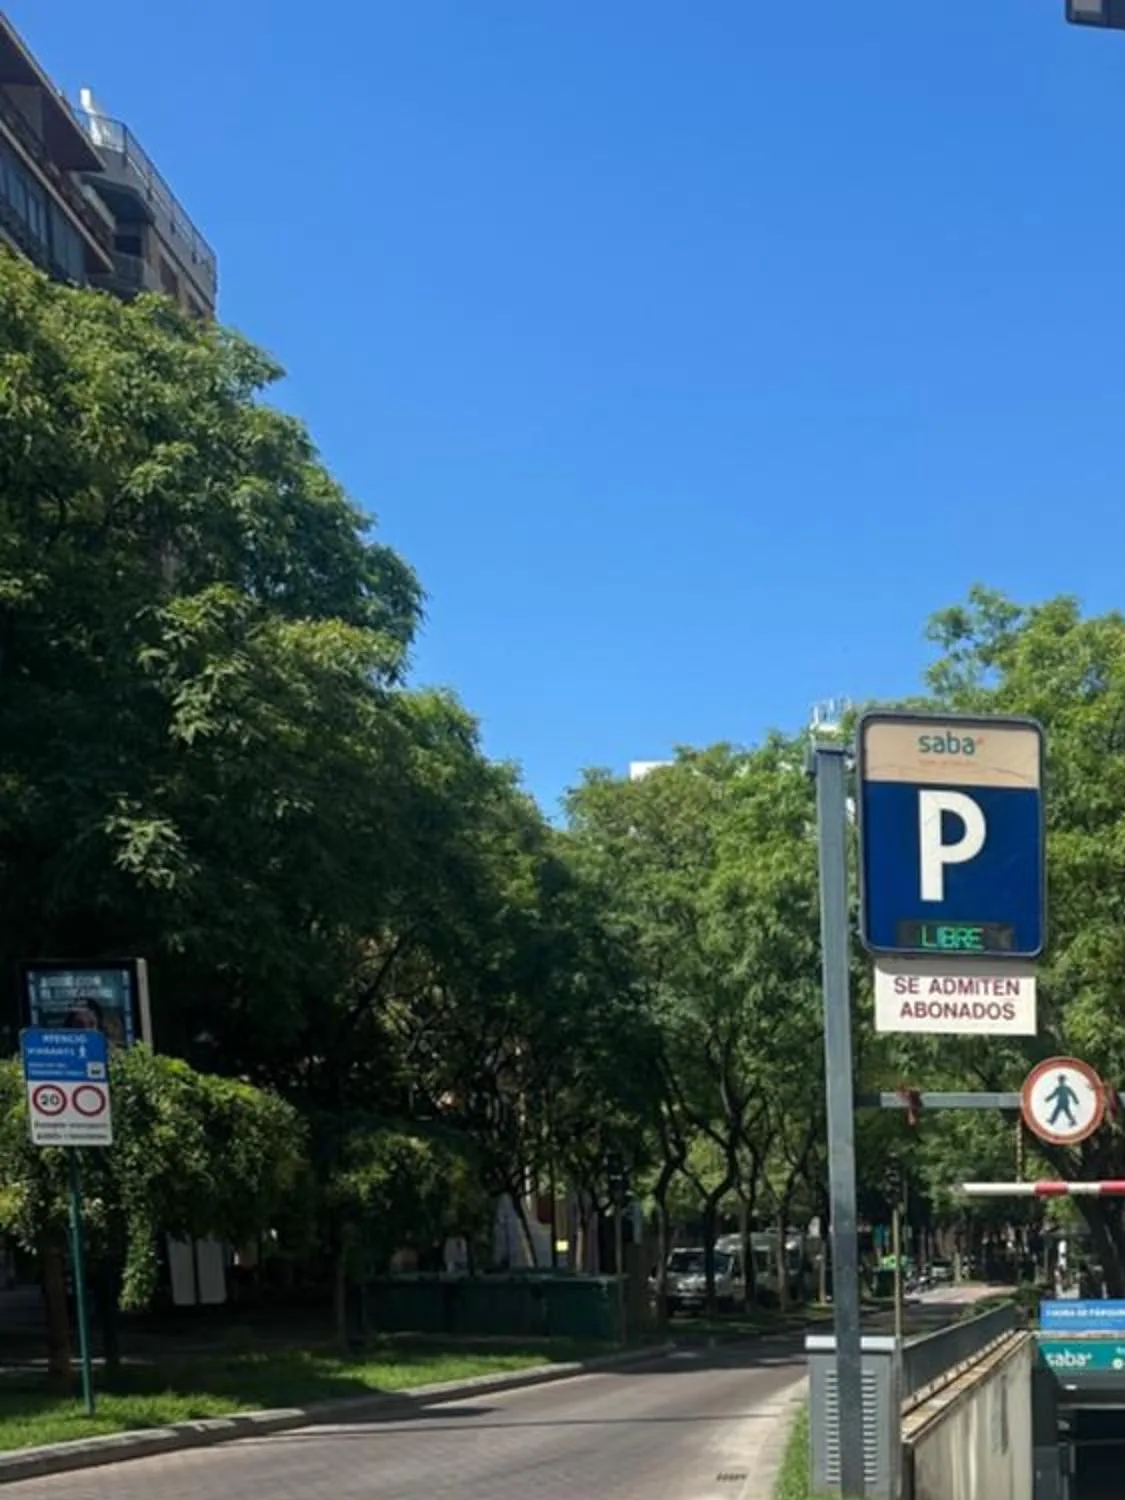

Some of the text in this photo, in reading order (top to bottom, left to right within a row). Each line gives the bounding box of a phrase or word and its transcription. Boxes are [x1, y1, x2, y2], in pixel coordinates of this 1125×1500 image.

[918, 731, 975, 755] saba
[919, 789, 987, 902] P
[921, 925, 985, 949] LIBRE
[894, 976, 1020, 996] SE ADMITEN
[900, 1001, 1016, 1020] ABONADOS
[40, 1093, 60, 1106] 20
[1045, 1348, 1087, 1367] saba
